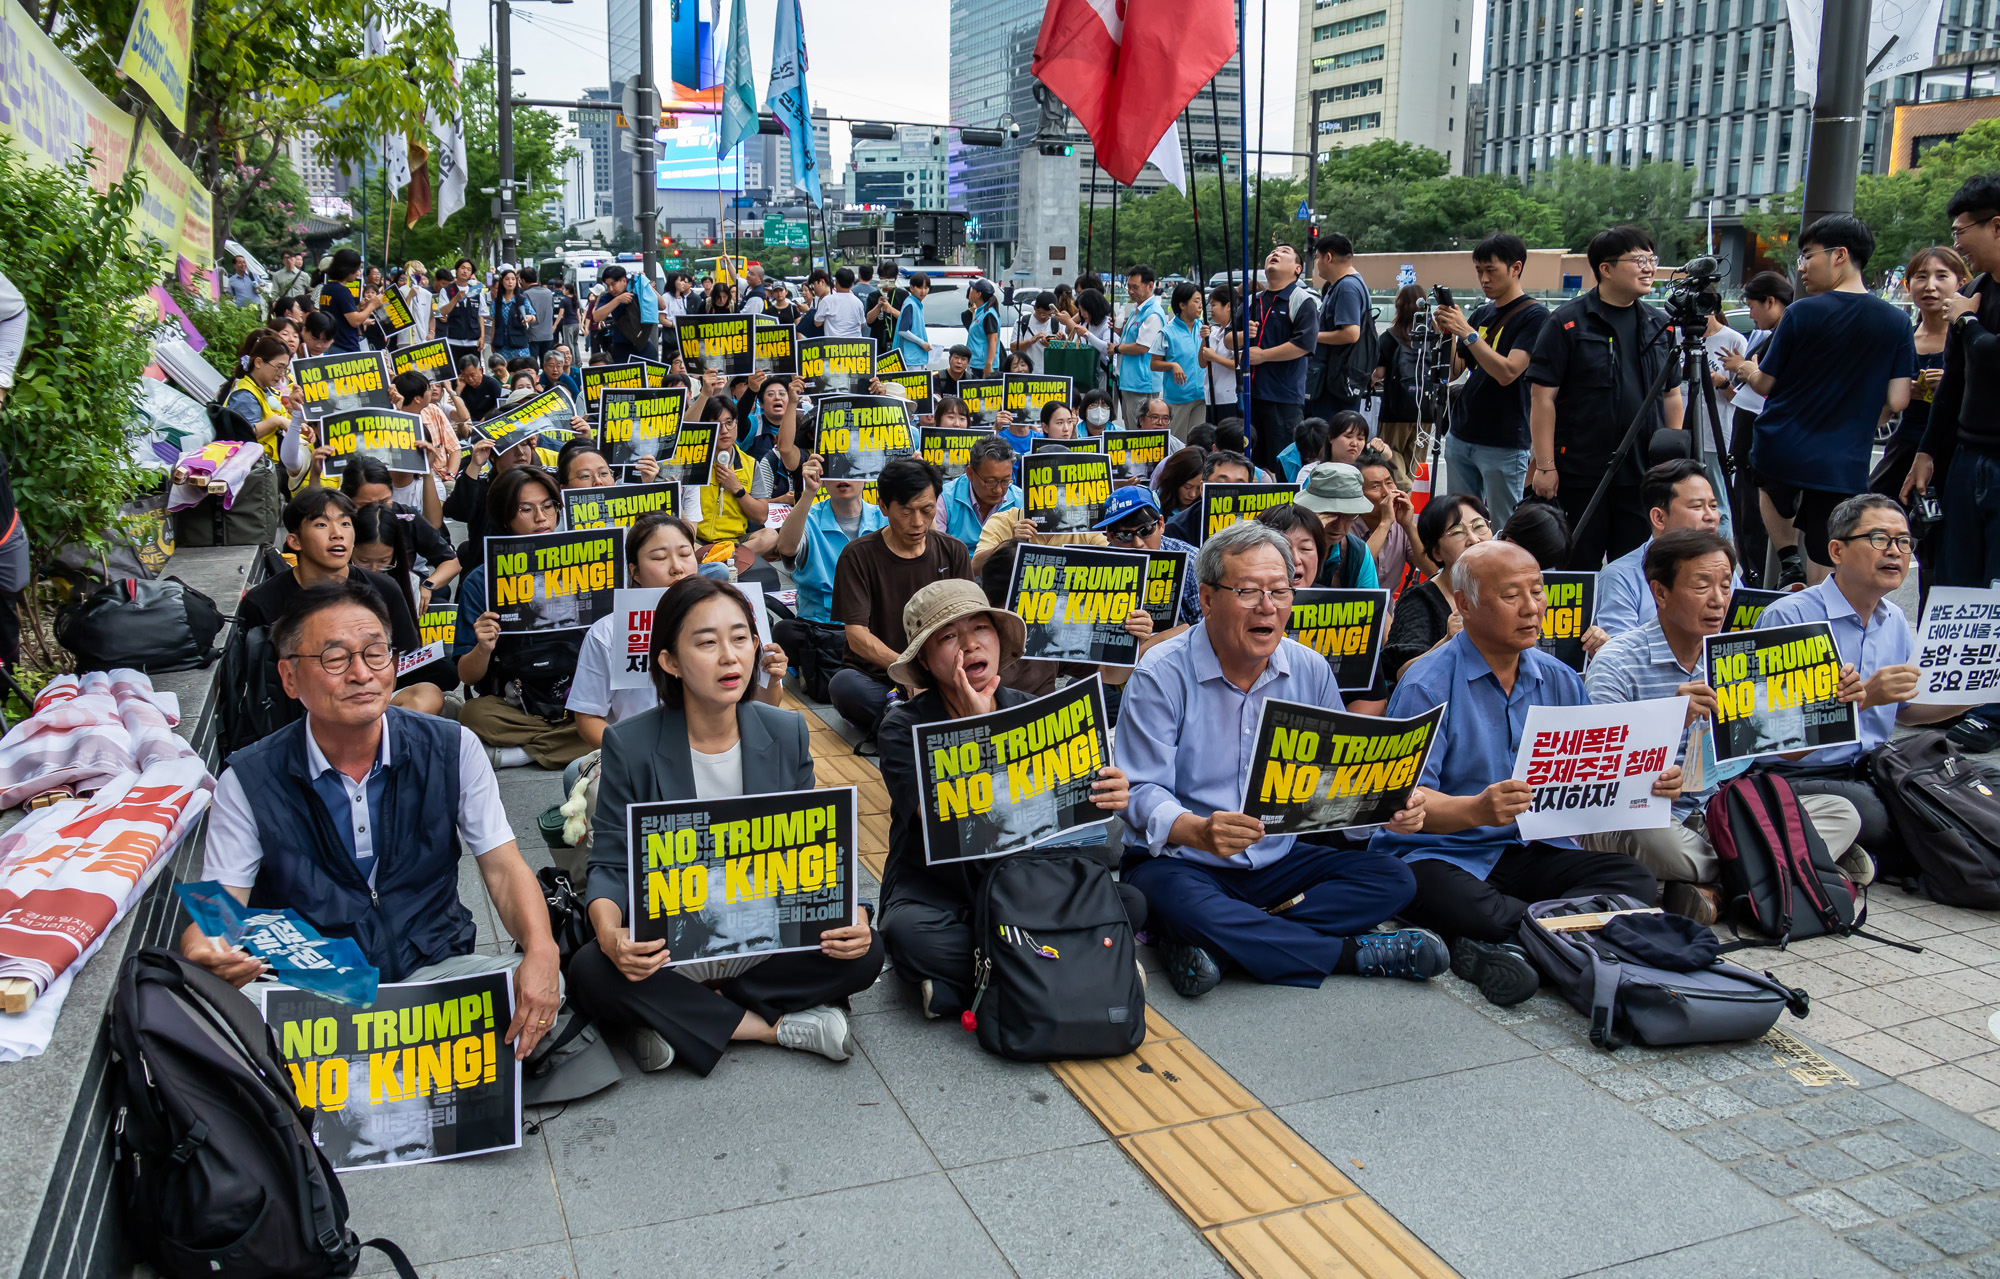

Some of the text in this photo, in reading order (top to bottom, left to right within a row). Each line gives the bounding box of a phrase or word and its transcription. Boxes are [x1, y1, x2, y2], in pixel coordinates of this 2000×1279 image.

[681, 320, 747, 339] NO TRUMP!
[756, 330, 789, 344] RUMP!
[394, 343, 444, 366] NO TRUMP!
[682, 334, 747, 358] NO KING!
[756, 341, 790, 359] KING!
[802, 344, 870, 361] NO TRUMP!
[300, 357, 378, 383] NO TRUMP!
[416, 352, 448, 371] KING!
[802, 357, 870, 378] NO KING!
[876, 353, 898, 369] RUMP!
[303, 371, 382, 403] NO KING!
[586, 367, 640, 386] NO TRUMP!
[1009, 382, 1066, 393] NO TRUMP!
[905, 385, 927, 400] ING!
[963, 385, 1003, 399] NO TRUM
[1008, 393, 1066, 409] NO KING!
[484, 392, 558, 432] NO TRUMP!
[608, 396, 680, 419] NO TRUMP!
[963, 397, 1003, 413] NO KIN
[328, 416, 414, 437] NO TRUMP!
[490, 398, 563, 439] NO KING!
[606, 419, 633, 443] NO
[640, 413, 678, 440] KING!
[823, 407, 903, 429] NO TRUMP!
[329, 430, 416, 456] NO KING!
[678, 430, 711, 444] UMP!
[820, 425, 910, 454] NO KING!
[925, 437, 941, 448] NO
[1108, 435, 1164, 451] NO TRUMP!
[924, 449, 944, 465] NO
[1108, 447, 1164, 465] NO KING!
[1030, 462, 1107, 486] NO TRUMP!
[573, 491, 671, 522] NO TRUMP!
[1029, 485, 1057, 510] NO
[1066, 480, 1110, 506] KING!
[1210, 491, 1293, 514] NO TRUMP!
[1209, 514, 1236, 537] NO
[497, 552, 527, 576] NO
[535, 538, 613, 573] TRUMP!
[497, 560, 614, 606] NO KING!
[1023, 566, 1139, 590] NO TRUMP!
[1543, 583, 1582, 606] MP!
[1017, 592, 1136, 624] NO KING!
[1291, 601, 1374, 629] TRUMP!
[1733, 606, 1765, 625] NO
[1931, 604, 1952, 620] 쌀도
[1542, 607, 1581, 639] NG!
[1928, 623, 1962, 640] 더이상
[1963, 622, 1991, 640] 내줄
[1298, 625, 1371, 656] KING!
[1716, 634, 1835, 684] NO TRUMP!
[1919, 643, 1996, 668] 농업·농민
[1717, 661, 1839, 724] NO KING!
[1929, 670, 1963, 692] 강요
[926, 725, 991, 751] 관세폭탄
[934, 694, 1094, 779] NO TRUMP!
[1270, 722, 1431, 763] NO TRUMP!
[1532, 725, 1629, 757] 관세폭탄
[937, 772, 993, 821] NO
[1007, 728, 1101, 804] KING!
[1260, 750, 1422, 803] NO KING!
[1526, 747, 1667, 785] 경제주권 침해
[640, 811, 711, 834] 관세폭탄
[648, 805, 836, 868] NO TRUMP!
[648, 842, 836, 919] NO KING!
[283, 991, 494, 1059] NO TRUMP!
[284, 1032, 496, 1112] NO KING!
